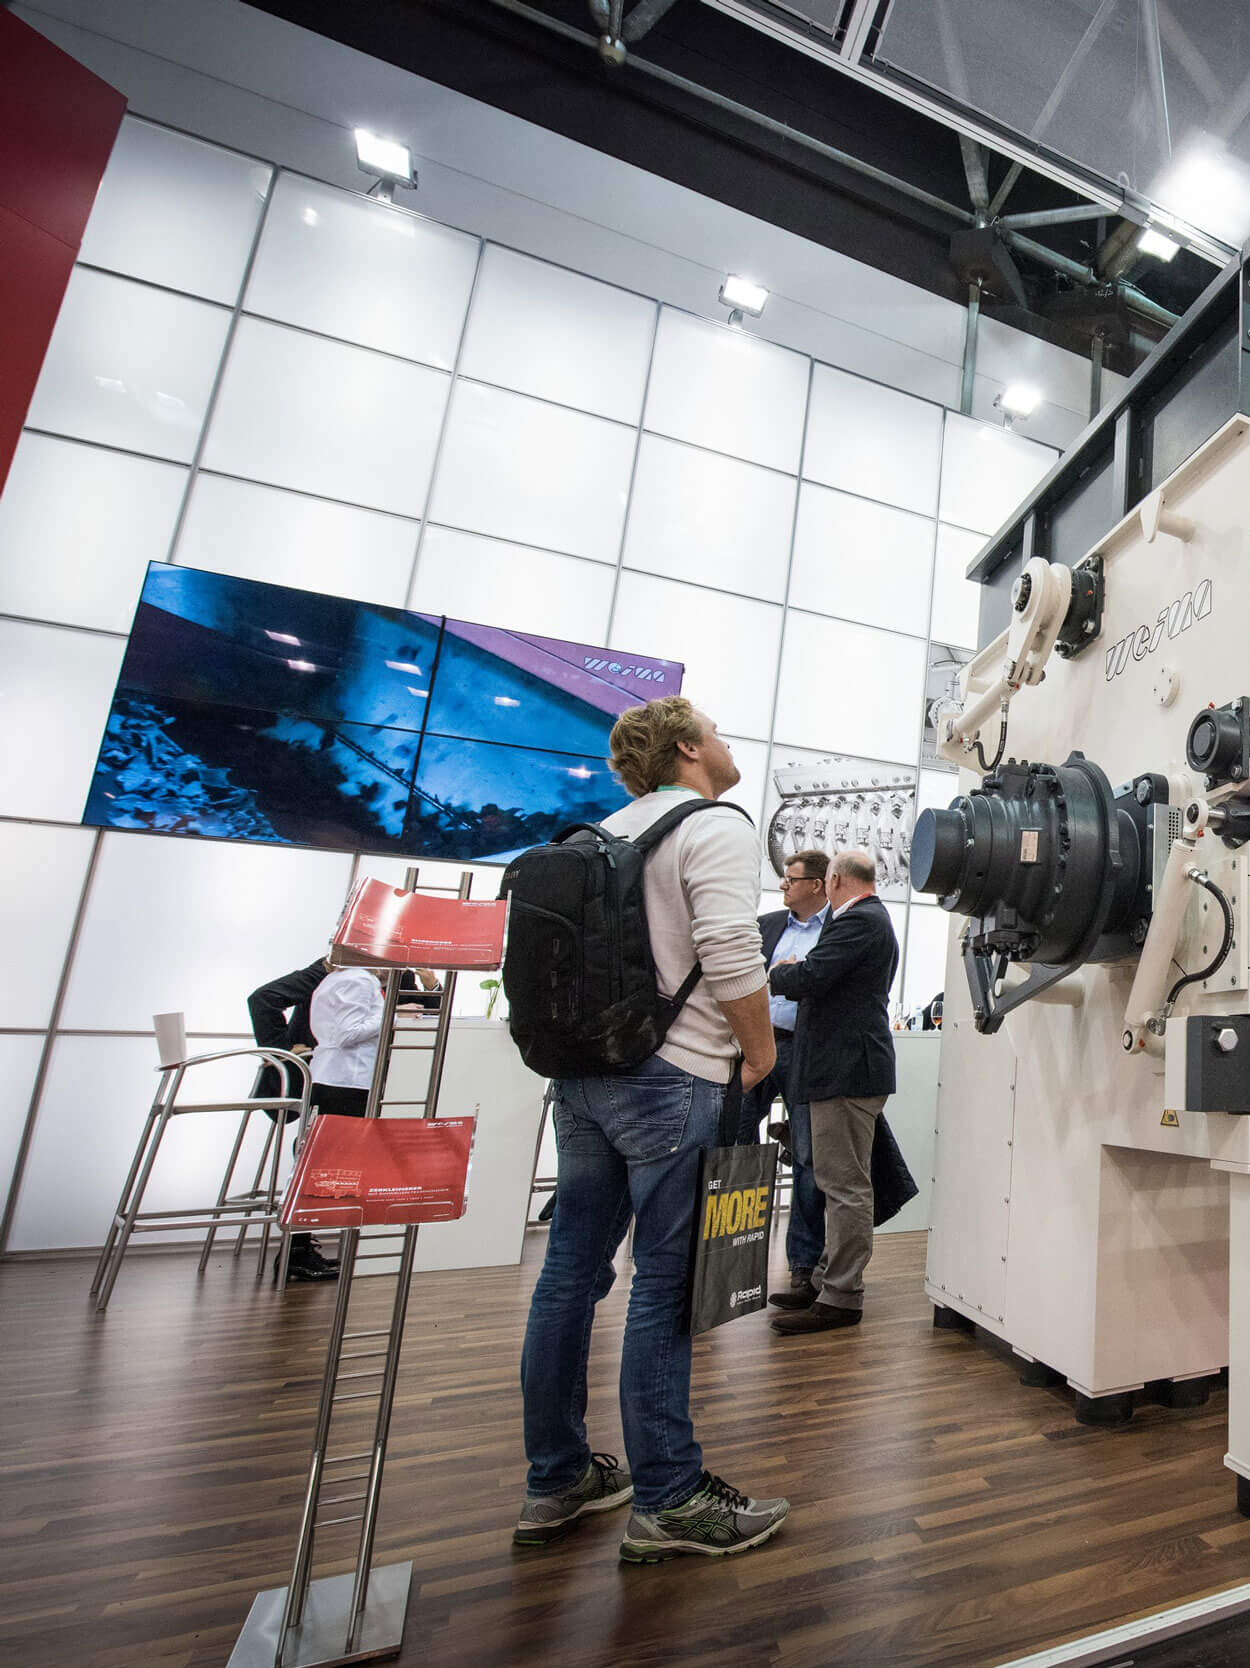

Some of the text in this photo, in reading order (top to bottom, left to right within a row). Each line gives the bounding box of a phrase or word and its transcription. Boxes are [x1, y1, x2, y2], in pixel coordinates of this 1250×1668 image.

[708, 1179, 721, 1190] GET
[702, 1186, 769, 1241] MORE
[732, 1230, 765, 1248] WITH RAPID
